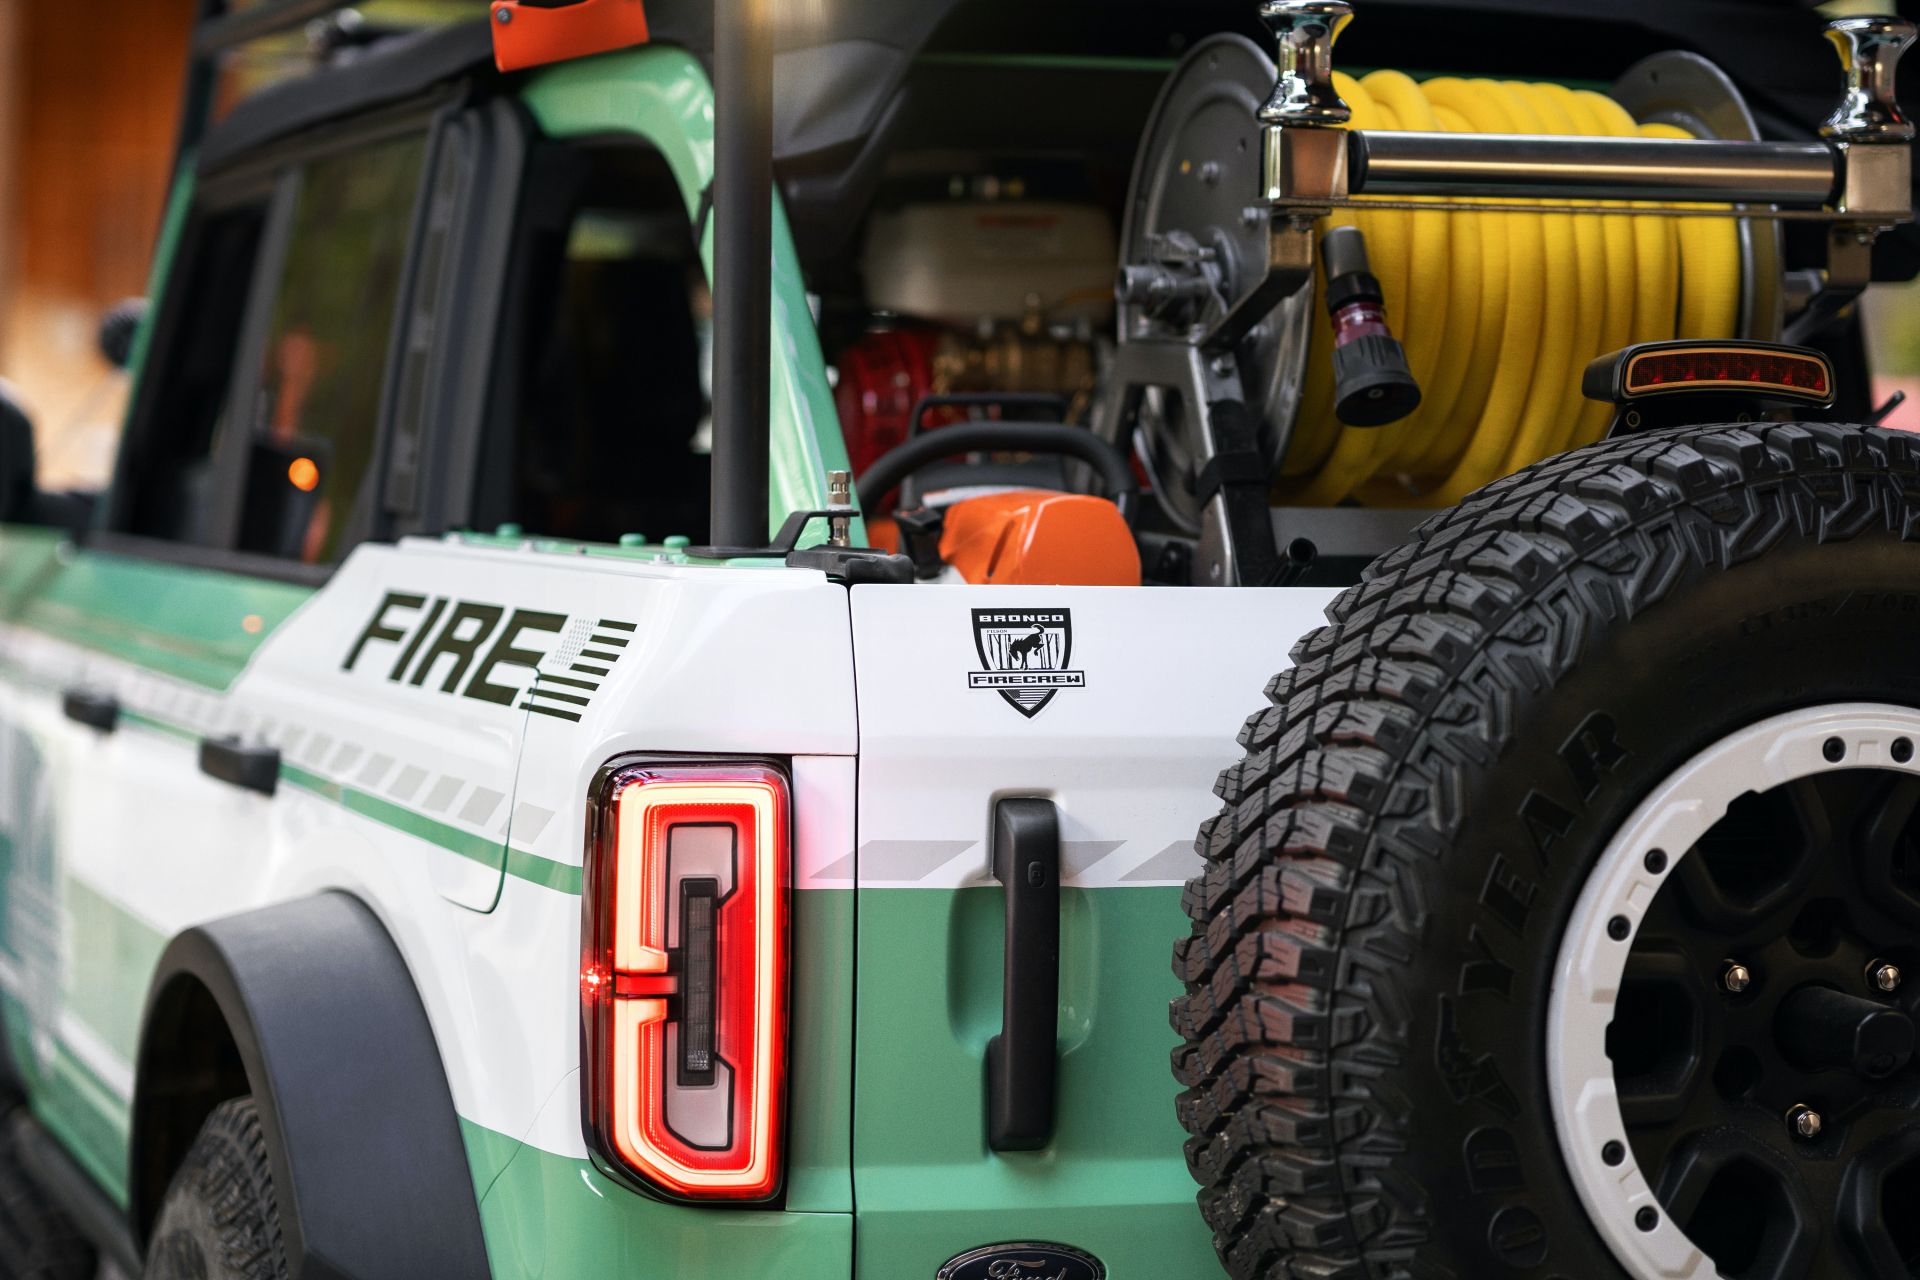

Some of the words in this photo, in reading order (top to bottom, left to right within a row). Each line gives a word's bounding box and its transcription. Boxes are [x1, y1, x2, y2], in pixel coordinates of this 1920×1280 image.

[979, 614, 1064, 622] BRONCO
[343, 591, 569, 706] FIRE
[973, 675, 1080, 684] FIRECREW
